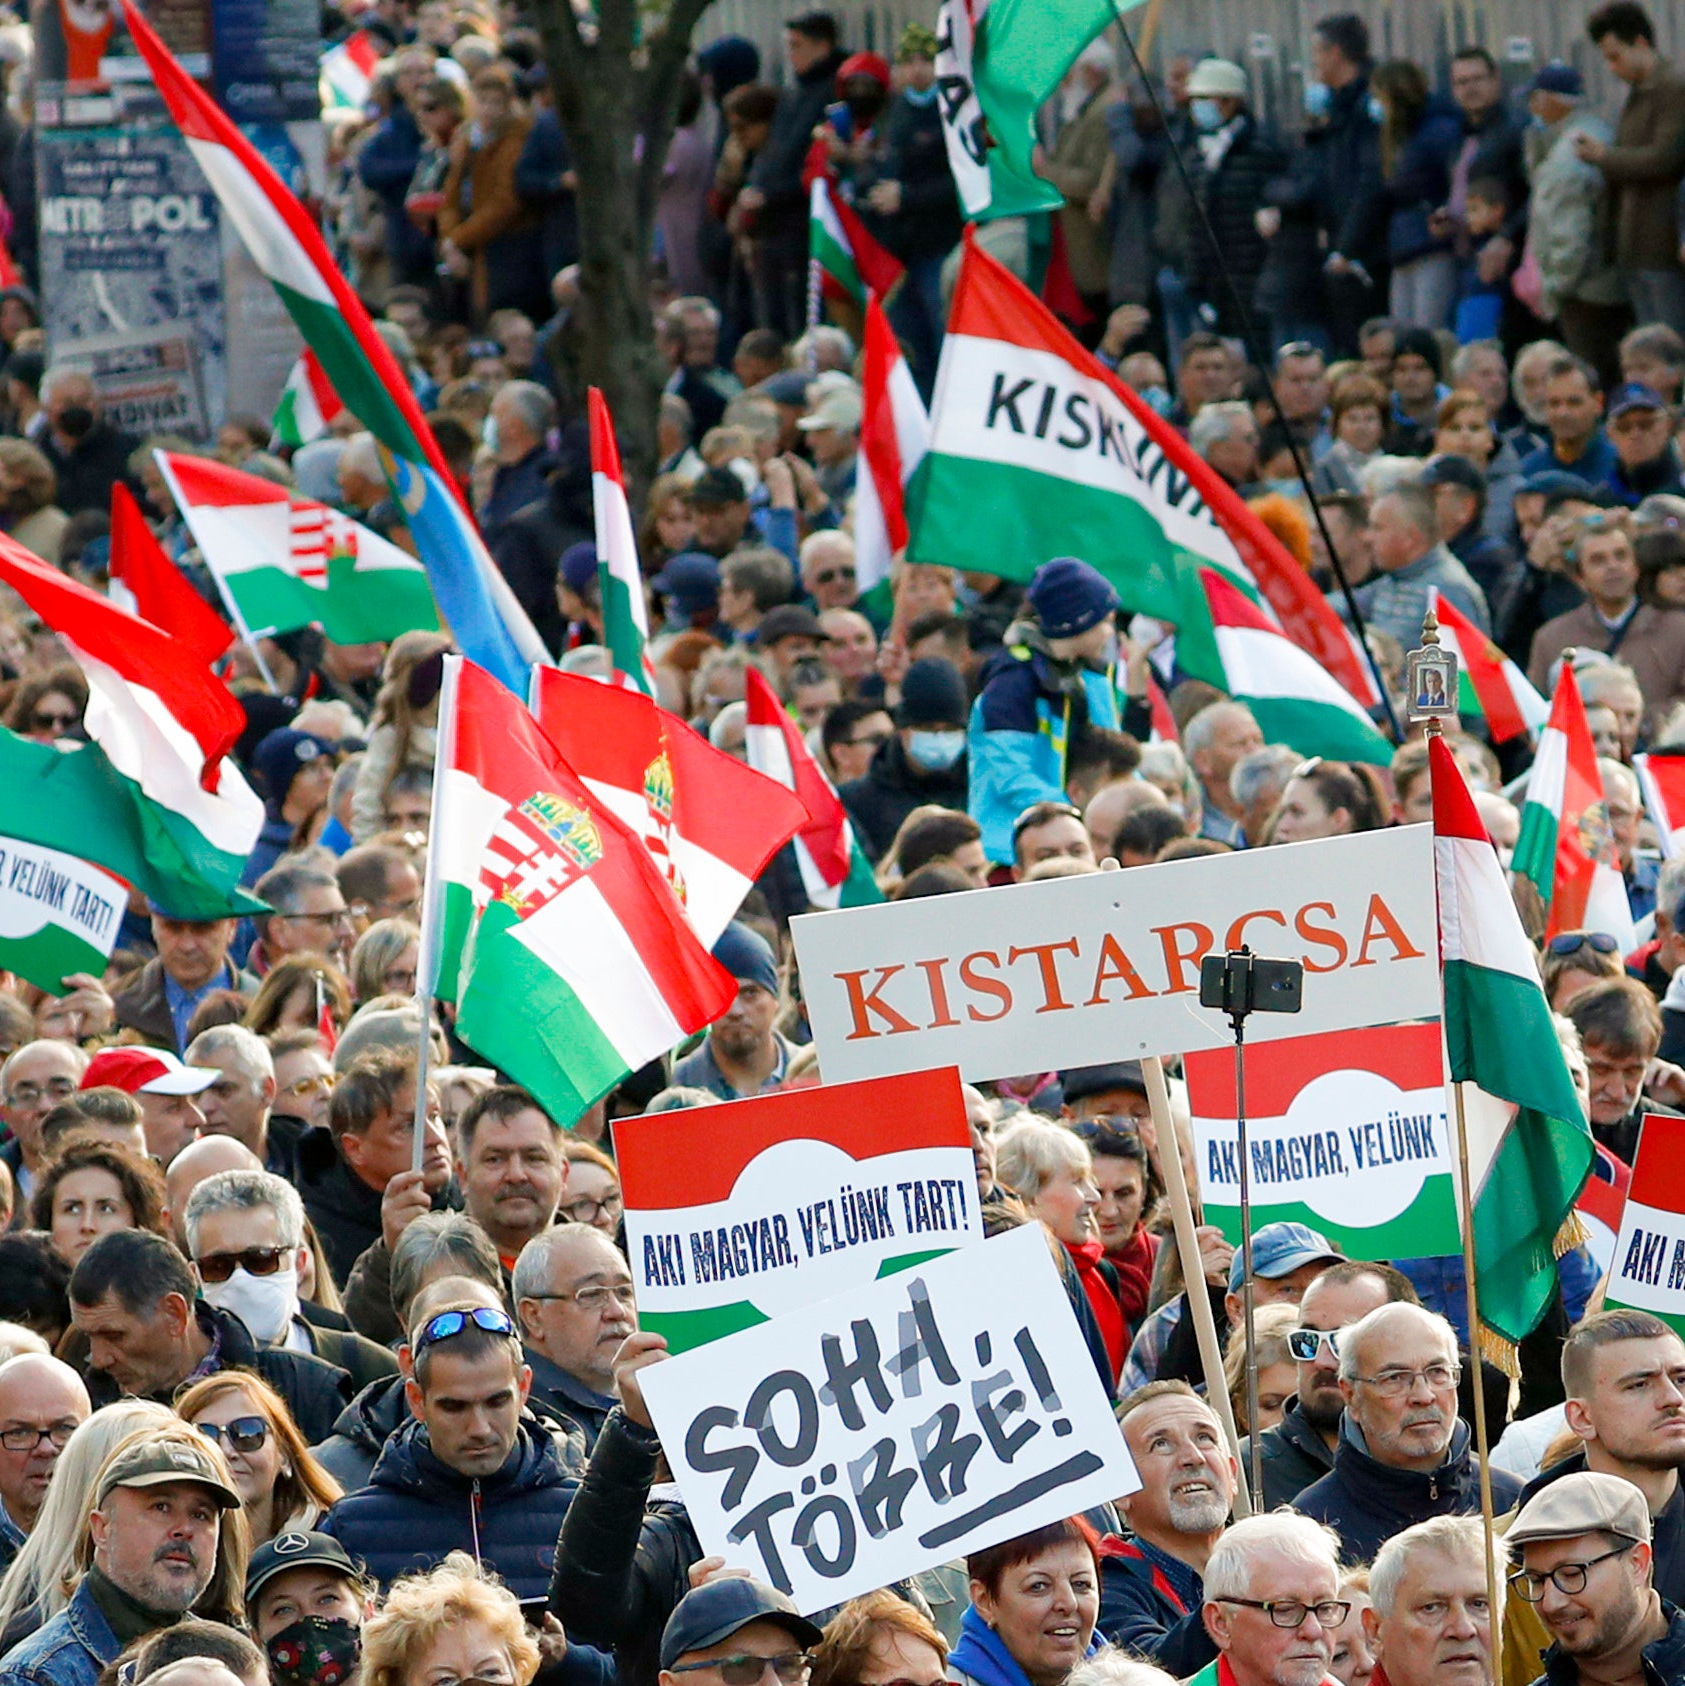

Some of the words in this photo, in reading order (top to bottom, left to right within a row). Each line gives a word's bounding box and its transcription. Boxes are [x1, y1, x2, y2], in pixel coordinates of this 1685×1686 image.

[9, 859, 71, 911] VELÜNK
[71, 882, 114, 939] TART!
[1208, 1138, 1238, 1185] AK
[1251, 1137, 1350, 1185] MAGYAR,
[1348, 1118, 1439, 1170] VELÜNK
[643, 1228, 687, 1287] AKI
[690, 1220, 798, 1285] MAGYAR,
[798, 1185, 894, 1259] VELÜNK
[896, 1179, 970, 1236] TART!
[1622, 1228, 1661, 1285] AKI
[726, 1325, 1074, 1598] TÖBBÉ!
